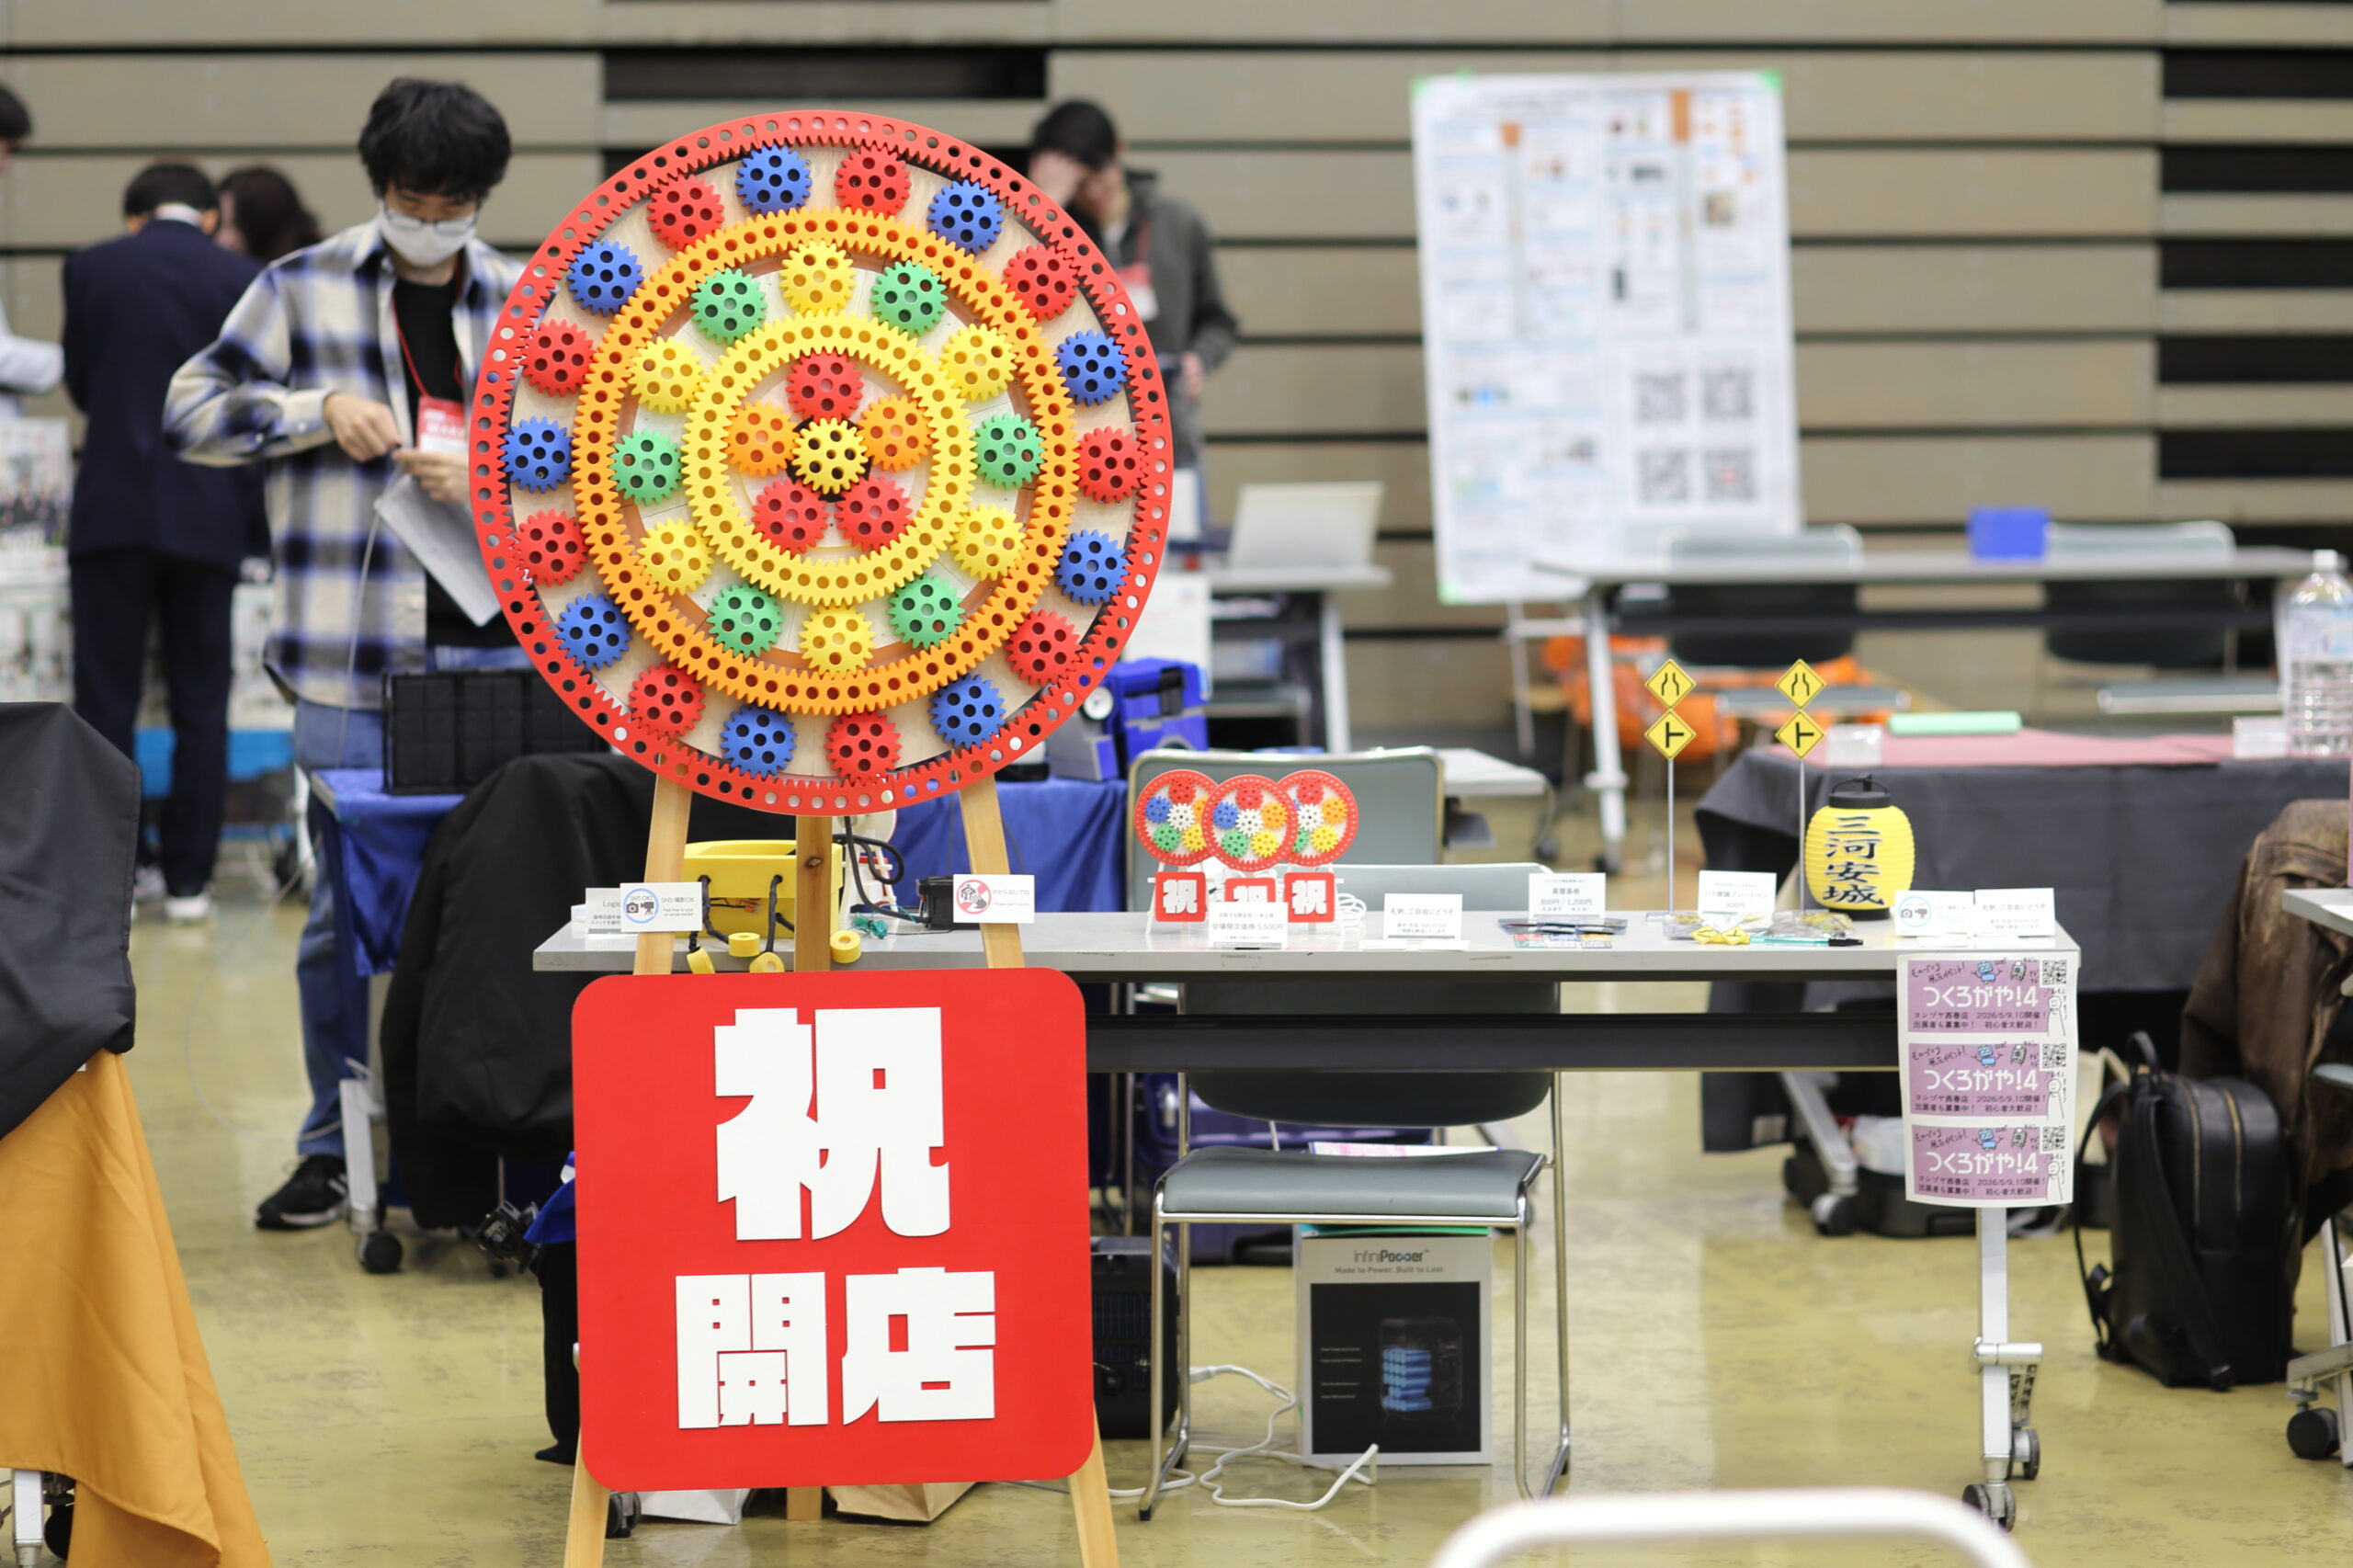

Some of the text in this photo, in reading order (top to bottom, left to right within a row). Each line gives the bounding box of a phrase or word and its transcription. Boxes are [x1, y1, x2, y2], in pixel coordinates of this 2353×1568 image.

[1823, 815, 1884, 905] 三河安城
[1163, 880, 1198, 915] 祝
[1291, 880, 1326, 915] 祝
[1923, 986, 2038, 1007] つくろがや!4
[1924, 1070, 2038, 1091] つくろがや!4
[714, 1006, 950, 1241] 祝
[1926, 1152, 2038, 1175] つくろがや!4
[675, 1267, 996, 1429] 開店
